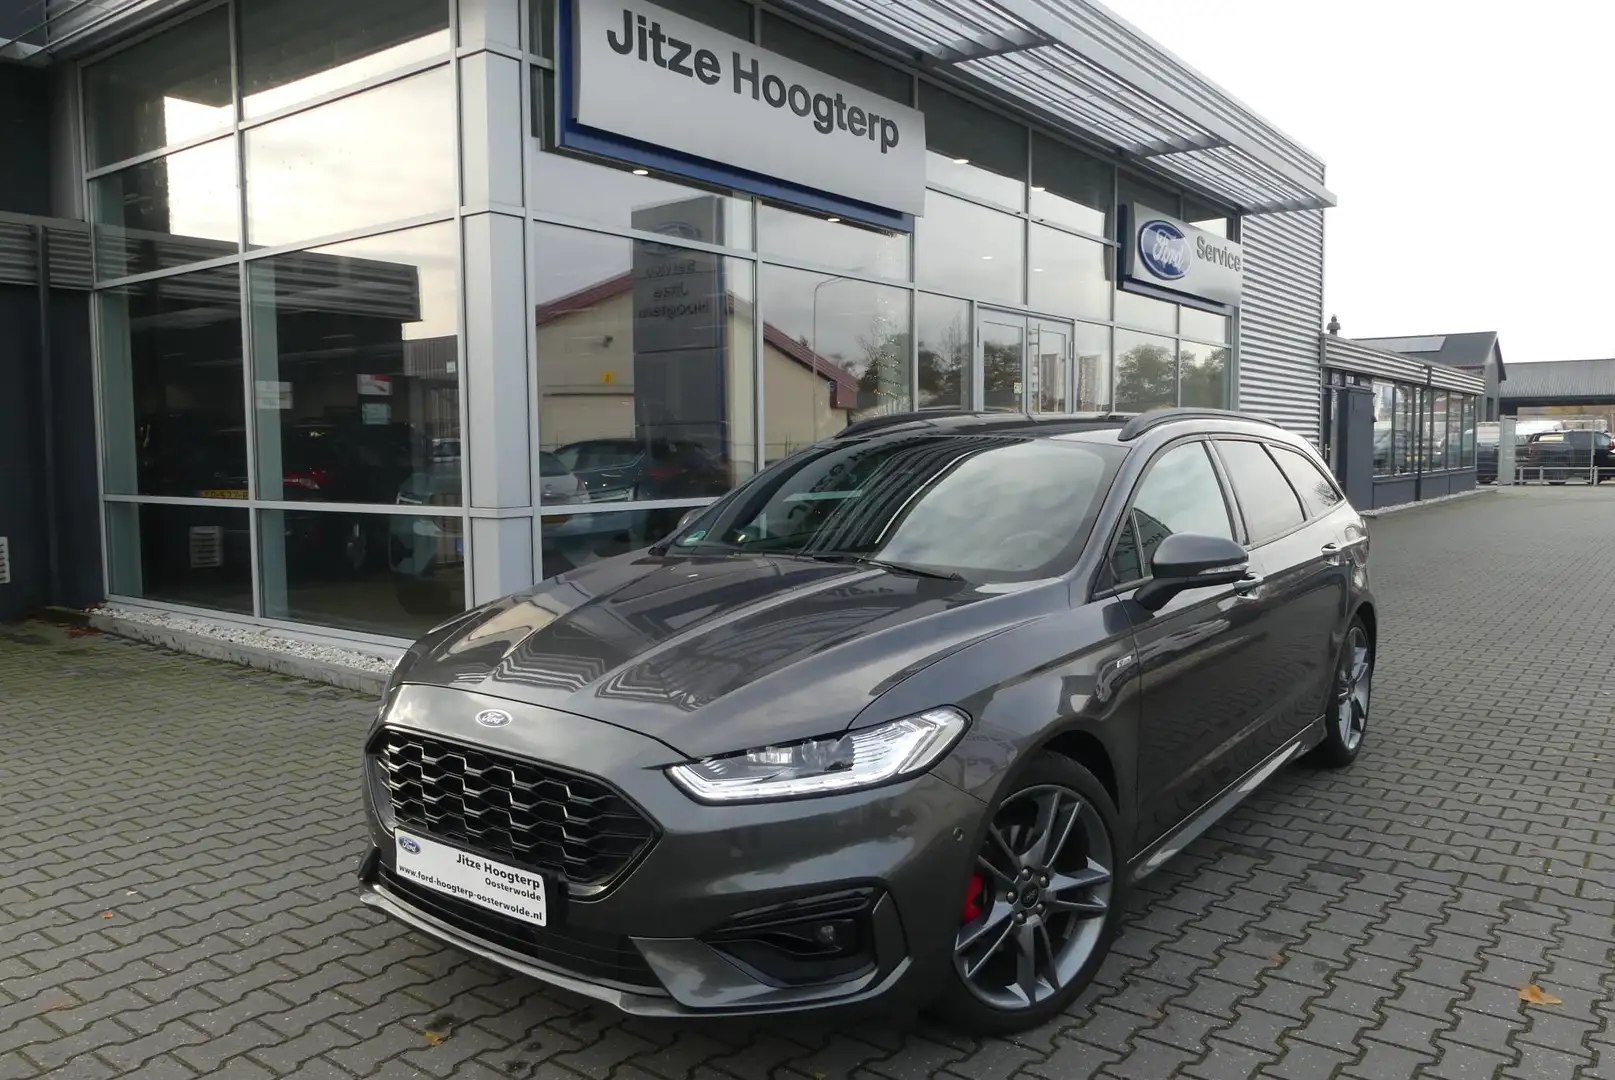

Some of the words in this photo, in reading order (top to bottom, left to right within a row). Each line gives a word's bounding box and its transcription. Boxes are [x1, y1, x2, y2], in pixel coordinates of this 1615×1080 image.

[606, 9, 721, 86] Jitze
[732, 51, 900, 154] Hoogterp
[1152, 228, 1187, 273] Ford
[1196, 235, 1241, 272] Service
[481, 711, 506, 724] Ford
[400, 839, 417, 852] Ford
[456, 853, 482, 871] Jitze
[484, 863, 541, 890] Hoogterp
[485, 877, 542, 902] Oosterwolde
[398, 864, 543, 921] www.ford-hoogterp-oosterwolde.nl
